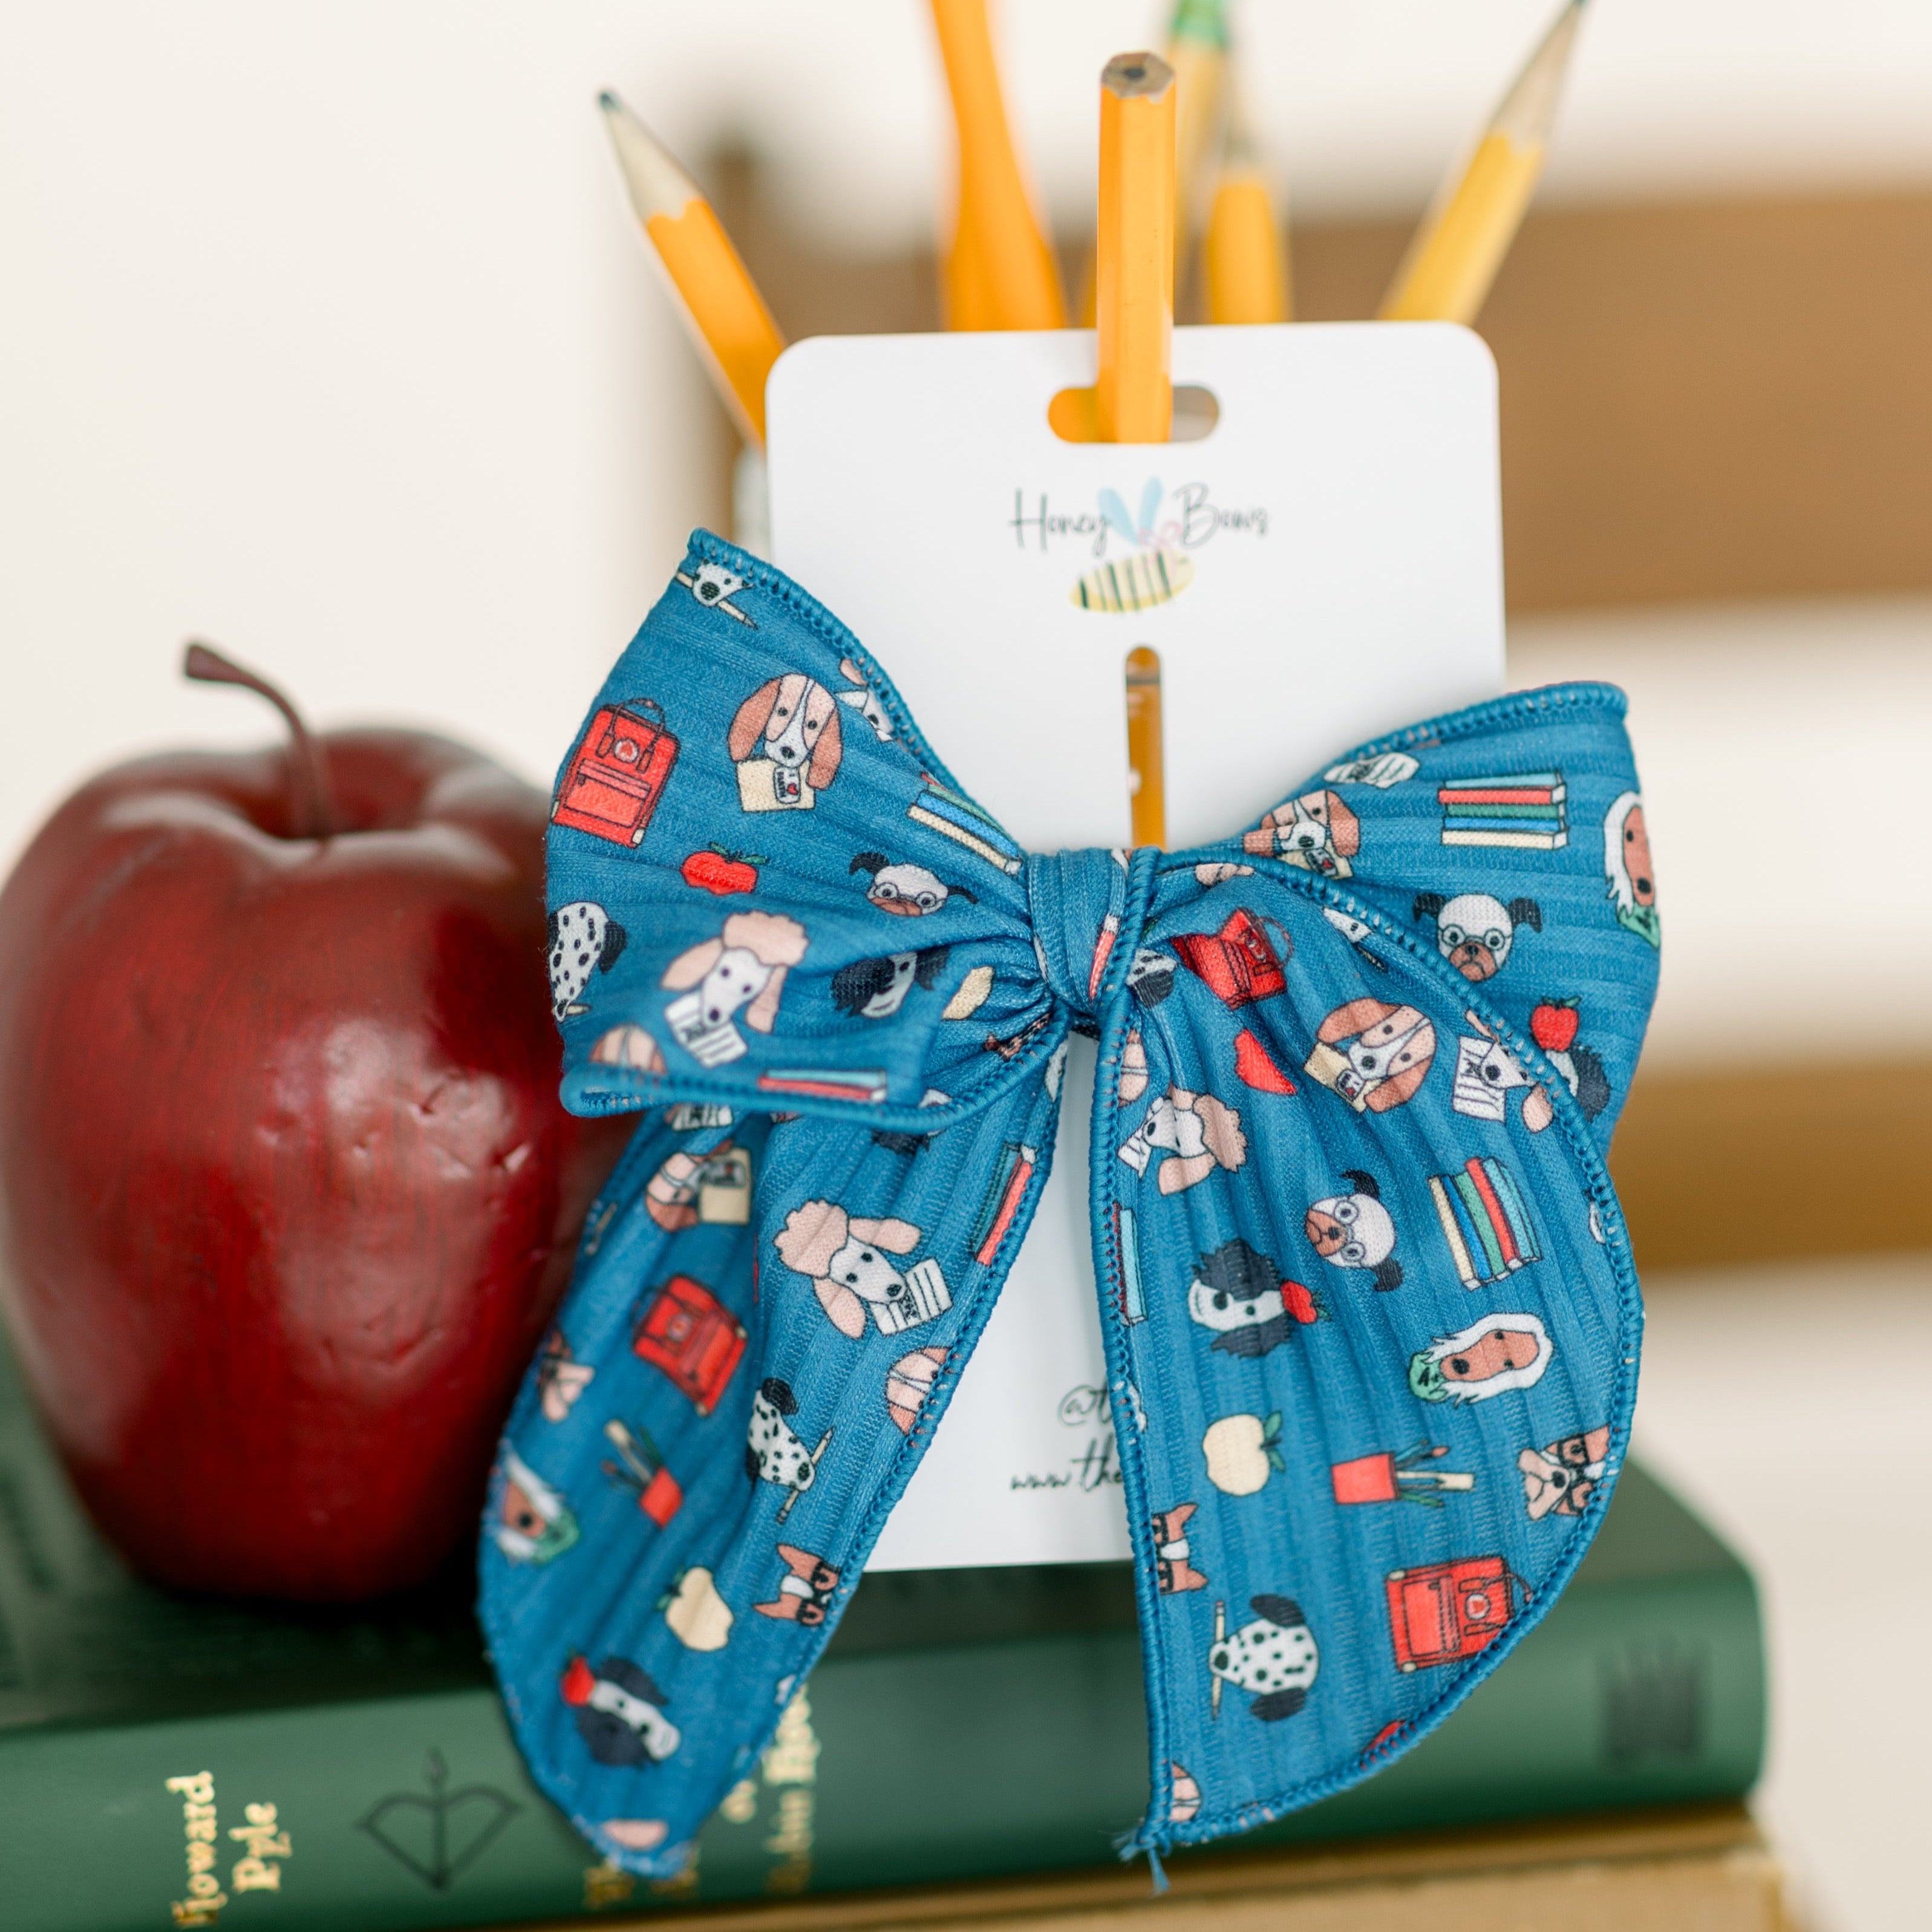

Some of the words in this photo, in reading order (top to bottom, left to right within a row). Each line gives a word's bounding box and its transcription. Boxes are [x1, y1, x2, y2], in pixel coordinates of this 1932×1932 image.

[1007, 488, 1108, 558] Honey
[1172, 482, 1268, 549] Bows
[228, 1801, 292, 1893] Pyle
